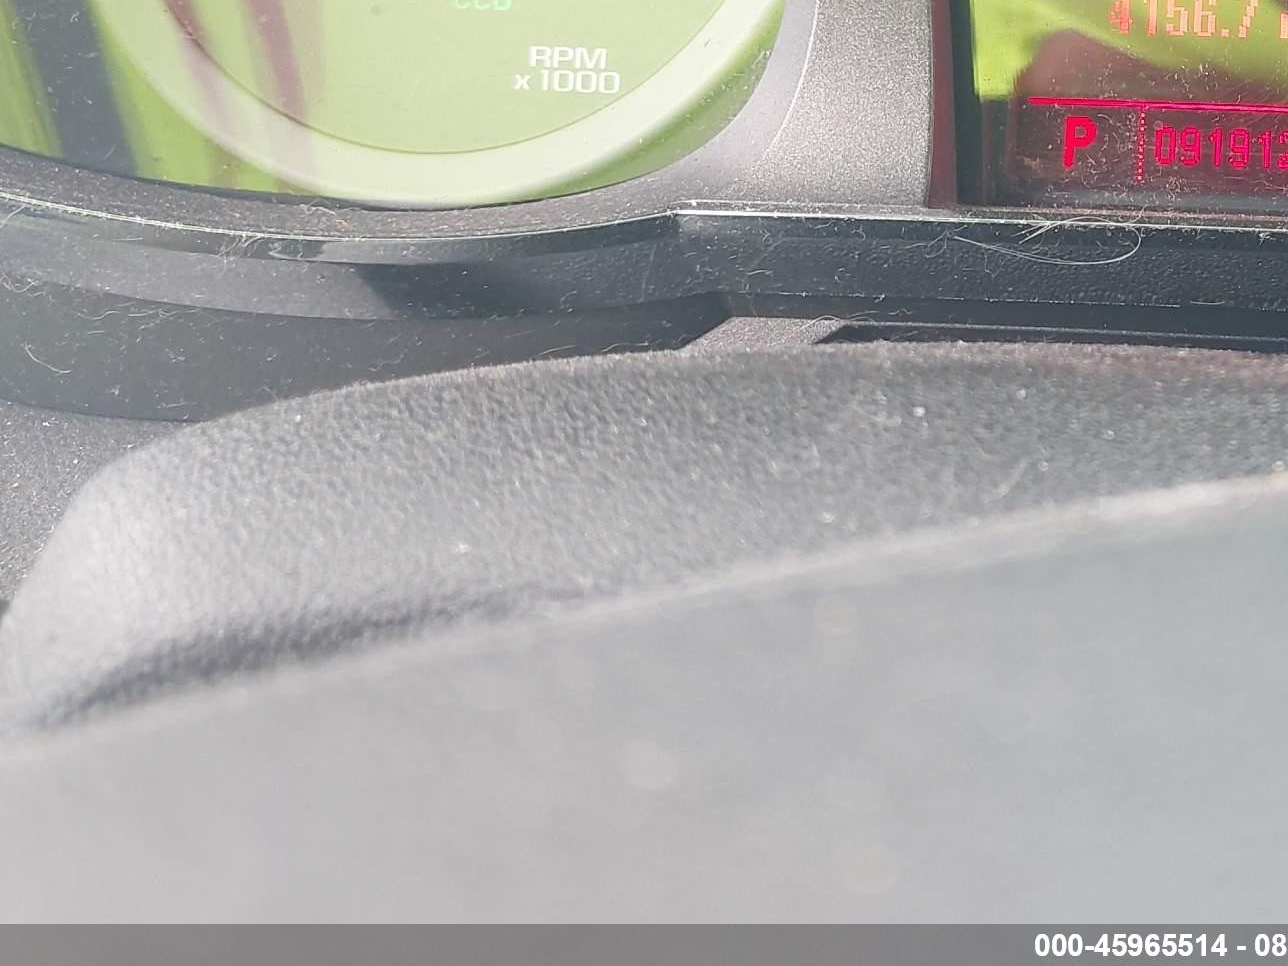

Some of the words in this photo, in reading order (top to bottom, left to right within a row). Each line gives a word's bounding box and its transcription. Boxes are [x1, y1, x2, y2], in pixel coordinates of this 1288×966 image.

[529, 46, 607, 70] RPM
[539, 70, 620, 94] 1000
[1063, 116, 1097, 168] P
